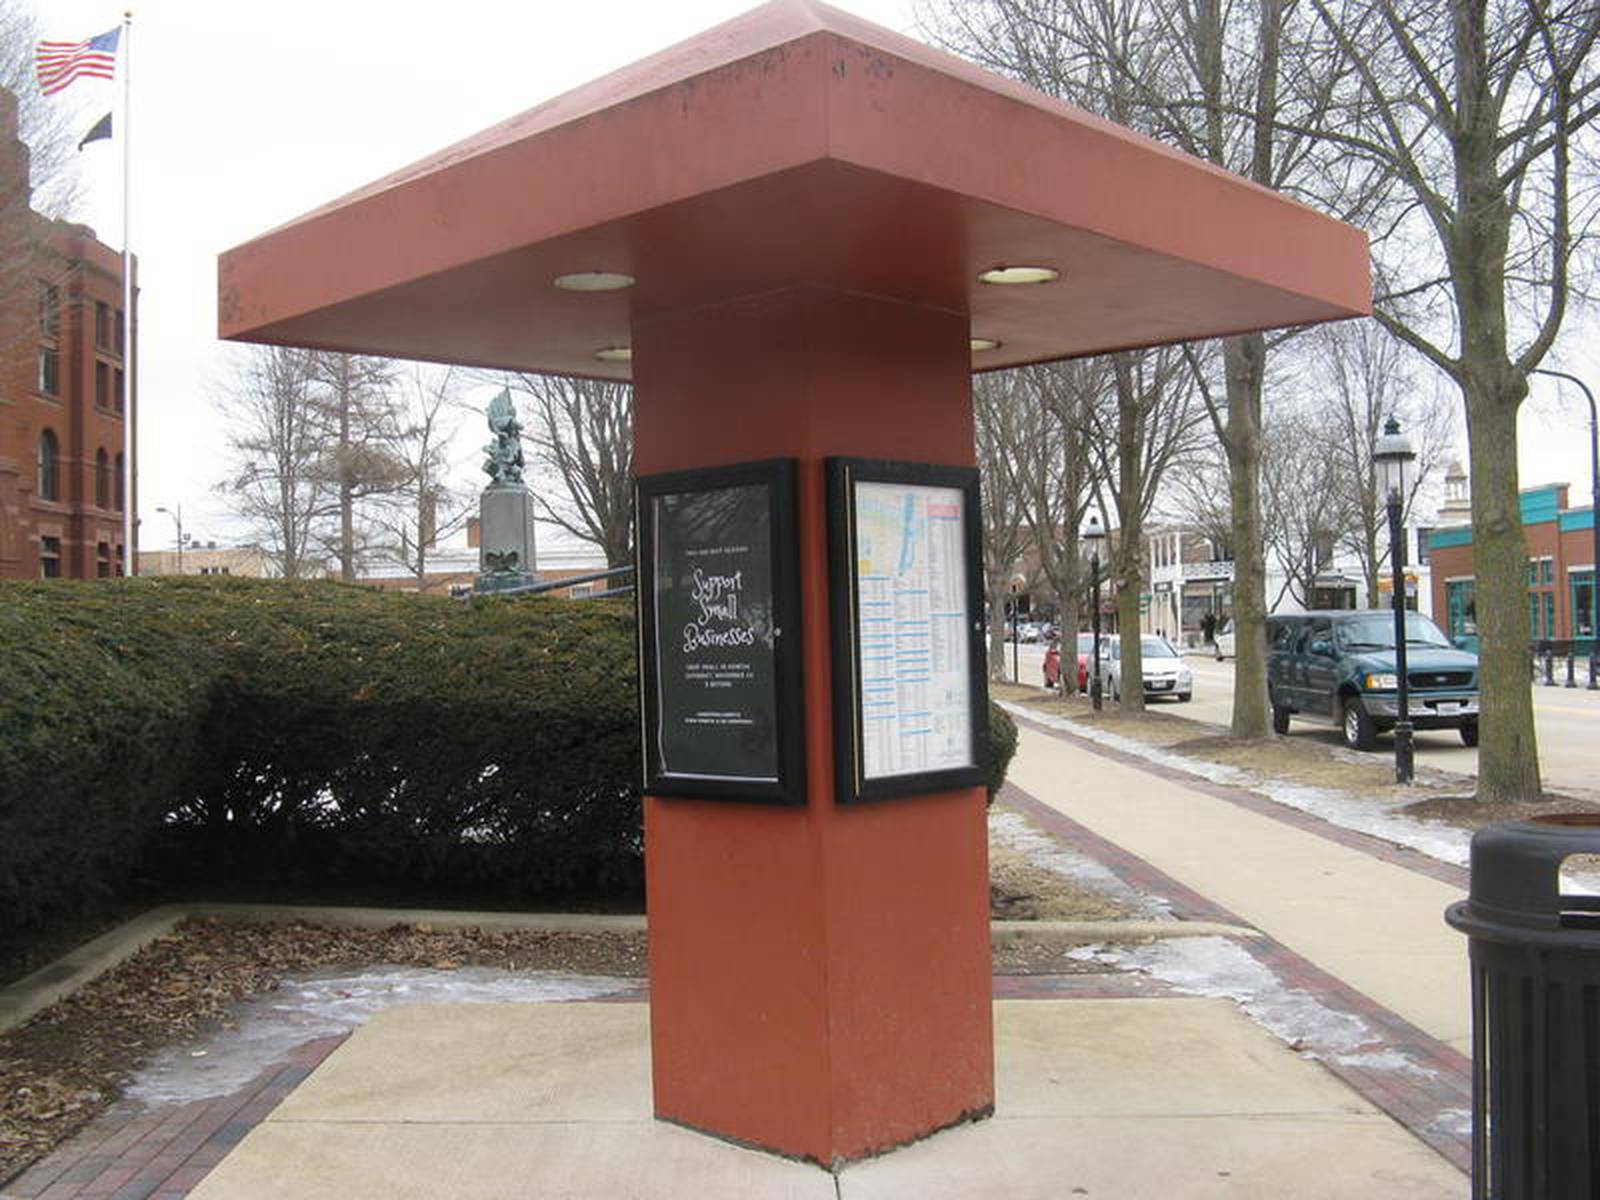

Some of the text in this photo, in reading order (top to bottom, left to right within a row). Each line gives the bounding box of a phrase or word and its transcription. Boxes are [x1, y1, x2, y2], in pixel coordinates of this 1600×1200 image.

[691, 568, 742, 602] Support
[698, 593, 738, 626] Small
[682, 622, 755, 653] Businesses
